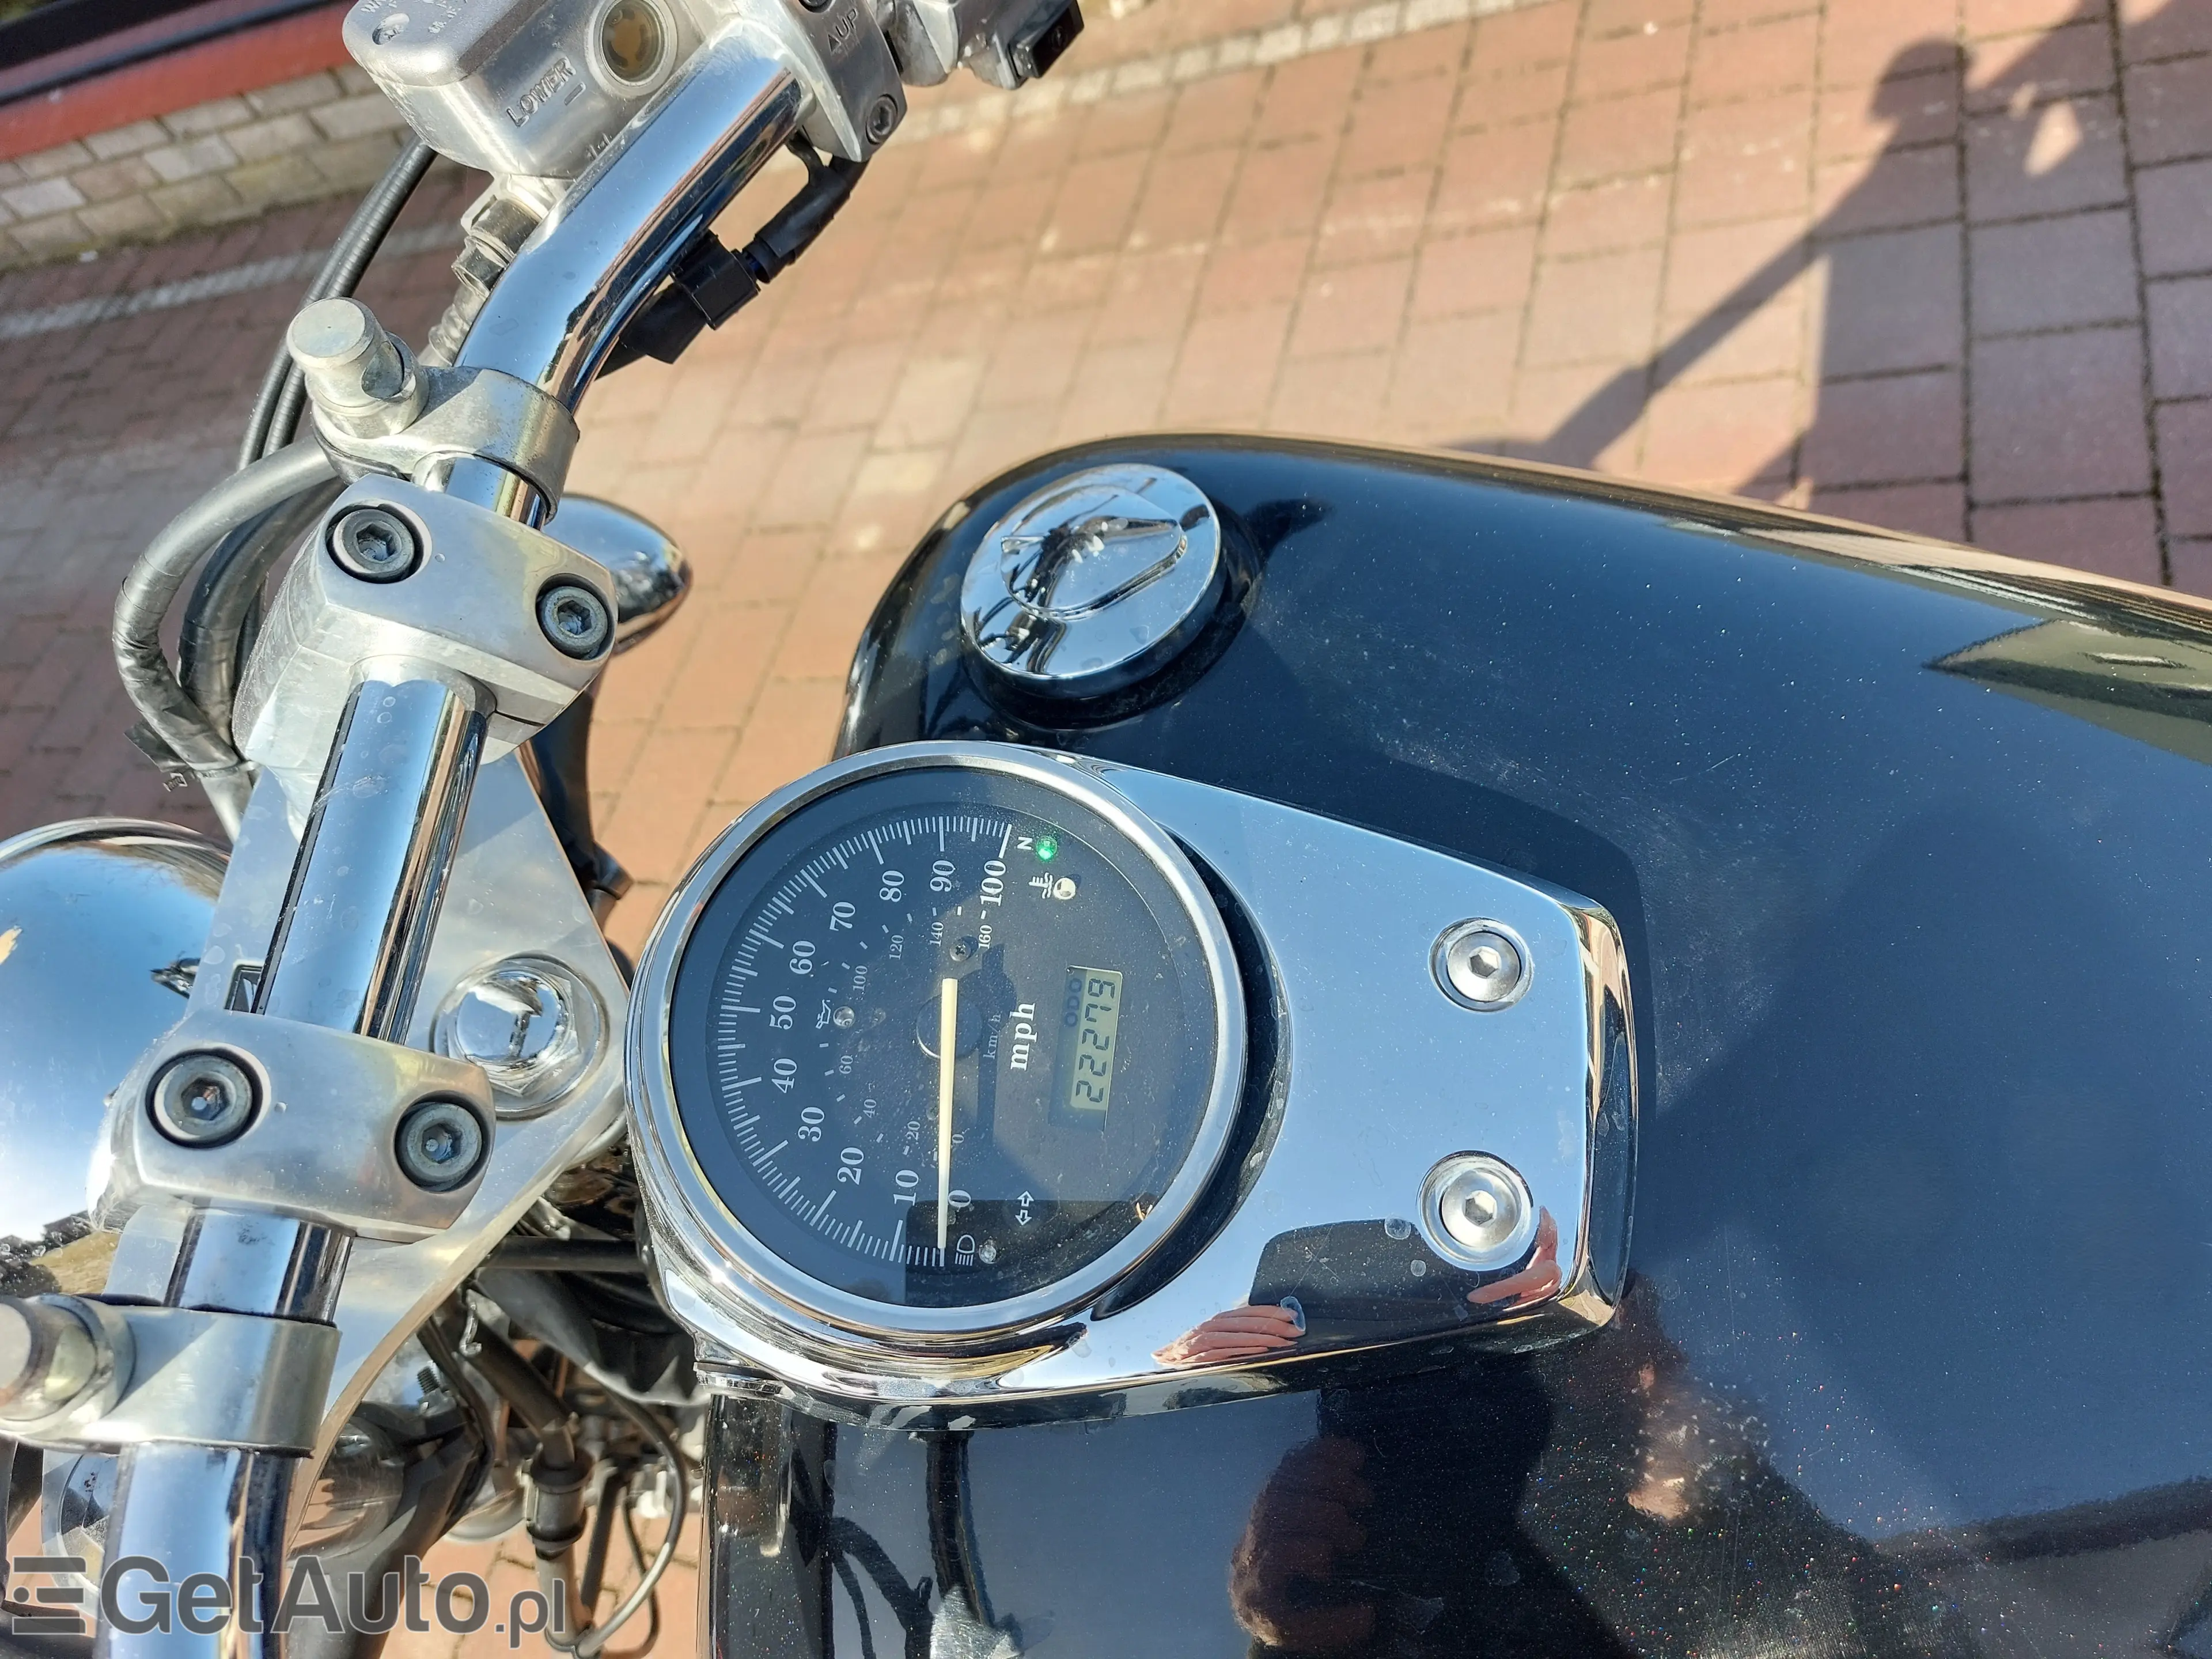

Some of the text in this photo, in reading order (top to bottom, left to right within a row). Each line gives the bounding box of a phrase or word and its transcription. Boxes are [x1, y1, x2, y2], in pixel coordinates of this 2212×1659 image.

[835, 8, 858, 40] UP
[506, 56, 577, 128] LOWER
[1017, 836, 1033, 850] N
[879, 870, 904, 902] 80
[930, 859, 954, 892] 90
[979, 859, 1006, 907] 100
[830, 902, 855, 931] 70
[889, 934, 904, 960] 120
[929, 921, 944, 947] 140
[978, 924, 993, 949] 160
[789, 941, 816, 975] 60
[853, 965, 868, 991] 100
[769, 995, 796, 1030] 50
[1065, 979, 1082, 1027] ODO
[983, 1013, 1001, 1059] km/h
[1009, 1002, 1037, 1071] mph
[1075, 978, 1115, 1103] 22279
[771, 1058, 797, 1093] 40
[839, 1055, 853, 1074] 60
[798, 1107, 824, 1142] 30
[863, 1099, 877, 1118] 40
[904, 1120, 921, 1141] 20
[952, 1134, 964, 1143] 0
[837, 1147, 864, 1185] 20
[893, 1169, 919, 1206] 10
[948, 1190, 971, 1208] 0
